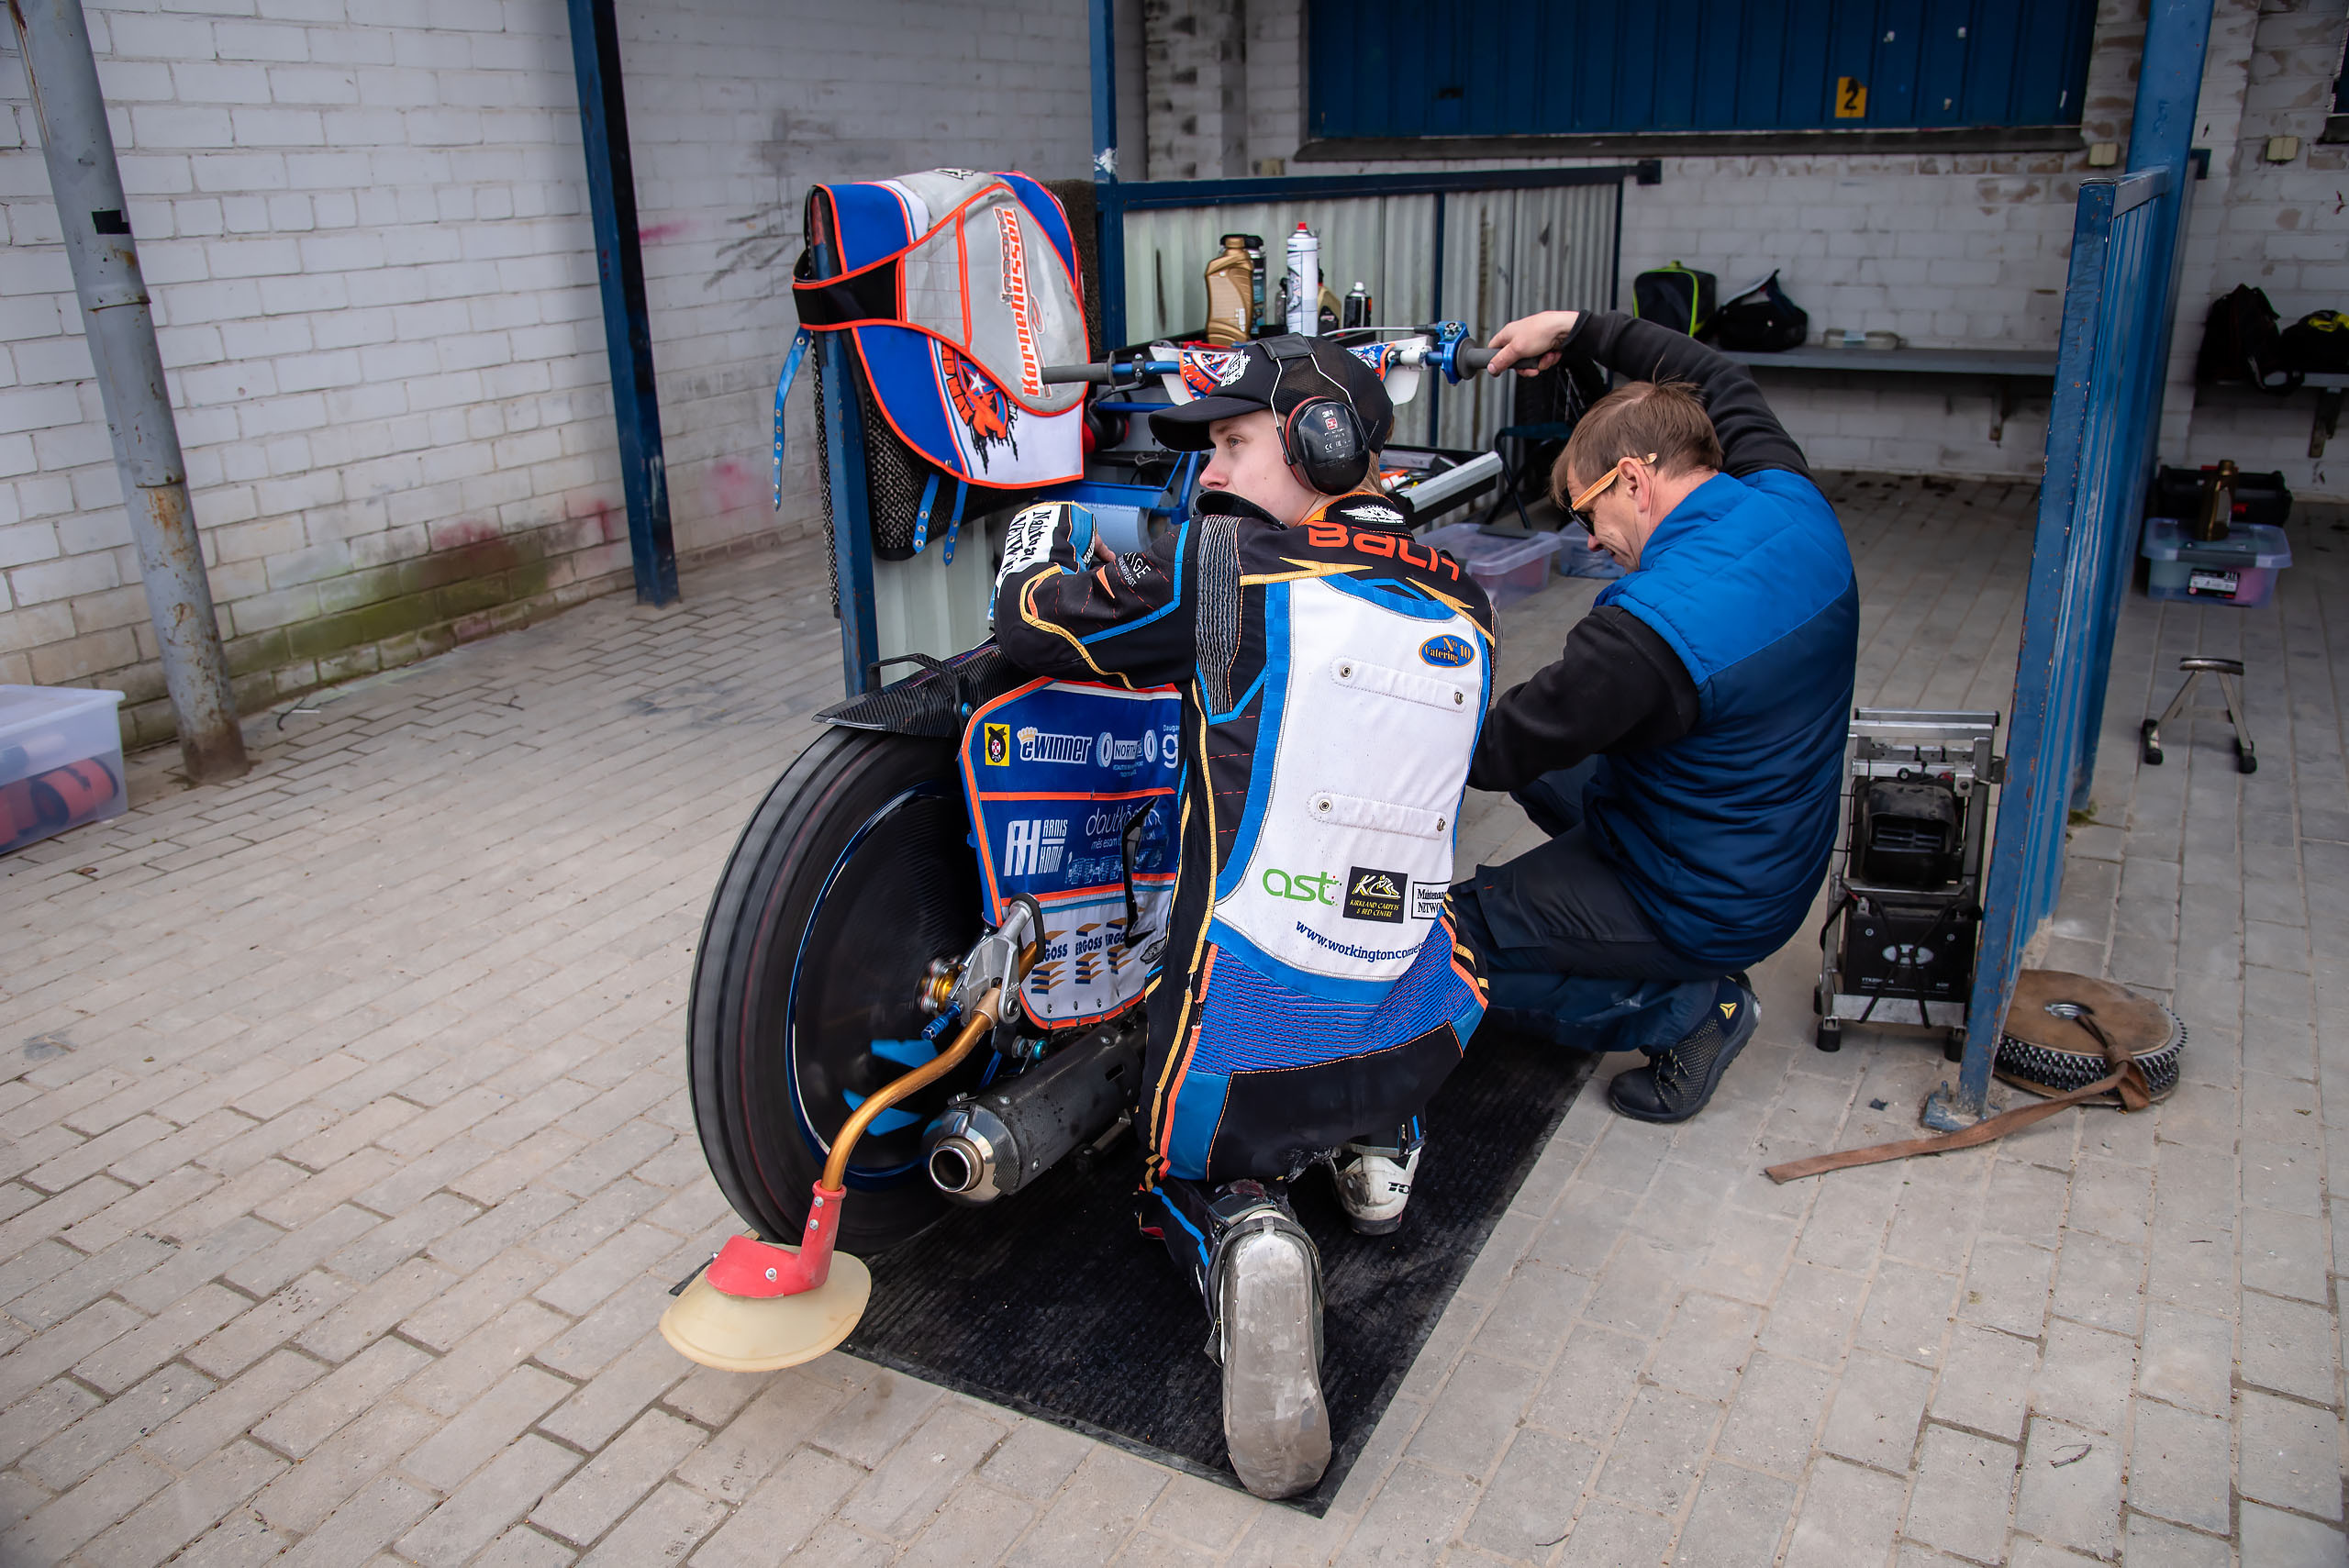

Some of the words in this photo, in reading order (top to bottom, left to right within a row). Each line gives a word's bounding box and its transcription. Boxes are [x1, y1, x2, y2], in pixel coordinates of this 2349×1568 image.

[1843, 77, 1859, 110] 2
[1425, 645, 1459, 665] Catering
[1460, 644, 1471, 660] 10
[1350, 899, 1376, 908] KIRKLAND
[1378, 903, 1399, 911] CARPETS
[1373, 909, 1393, 917] CENTRE
[1074, 936, 1103, 956] ERGOSS
